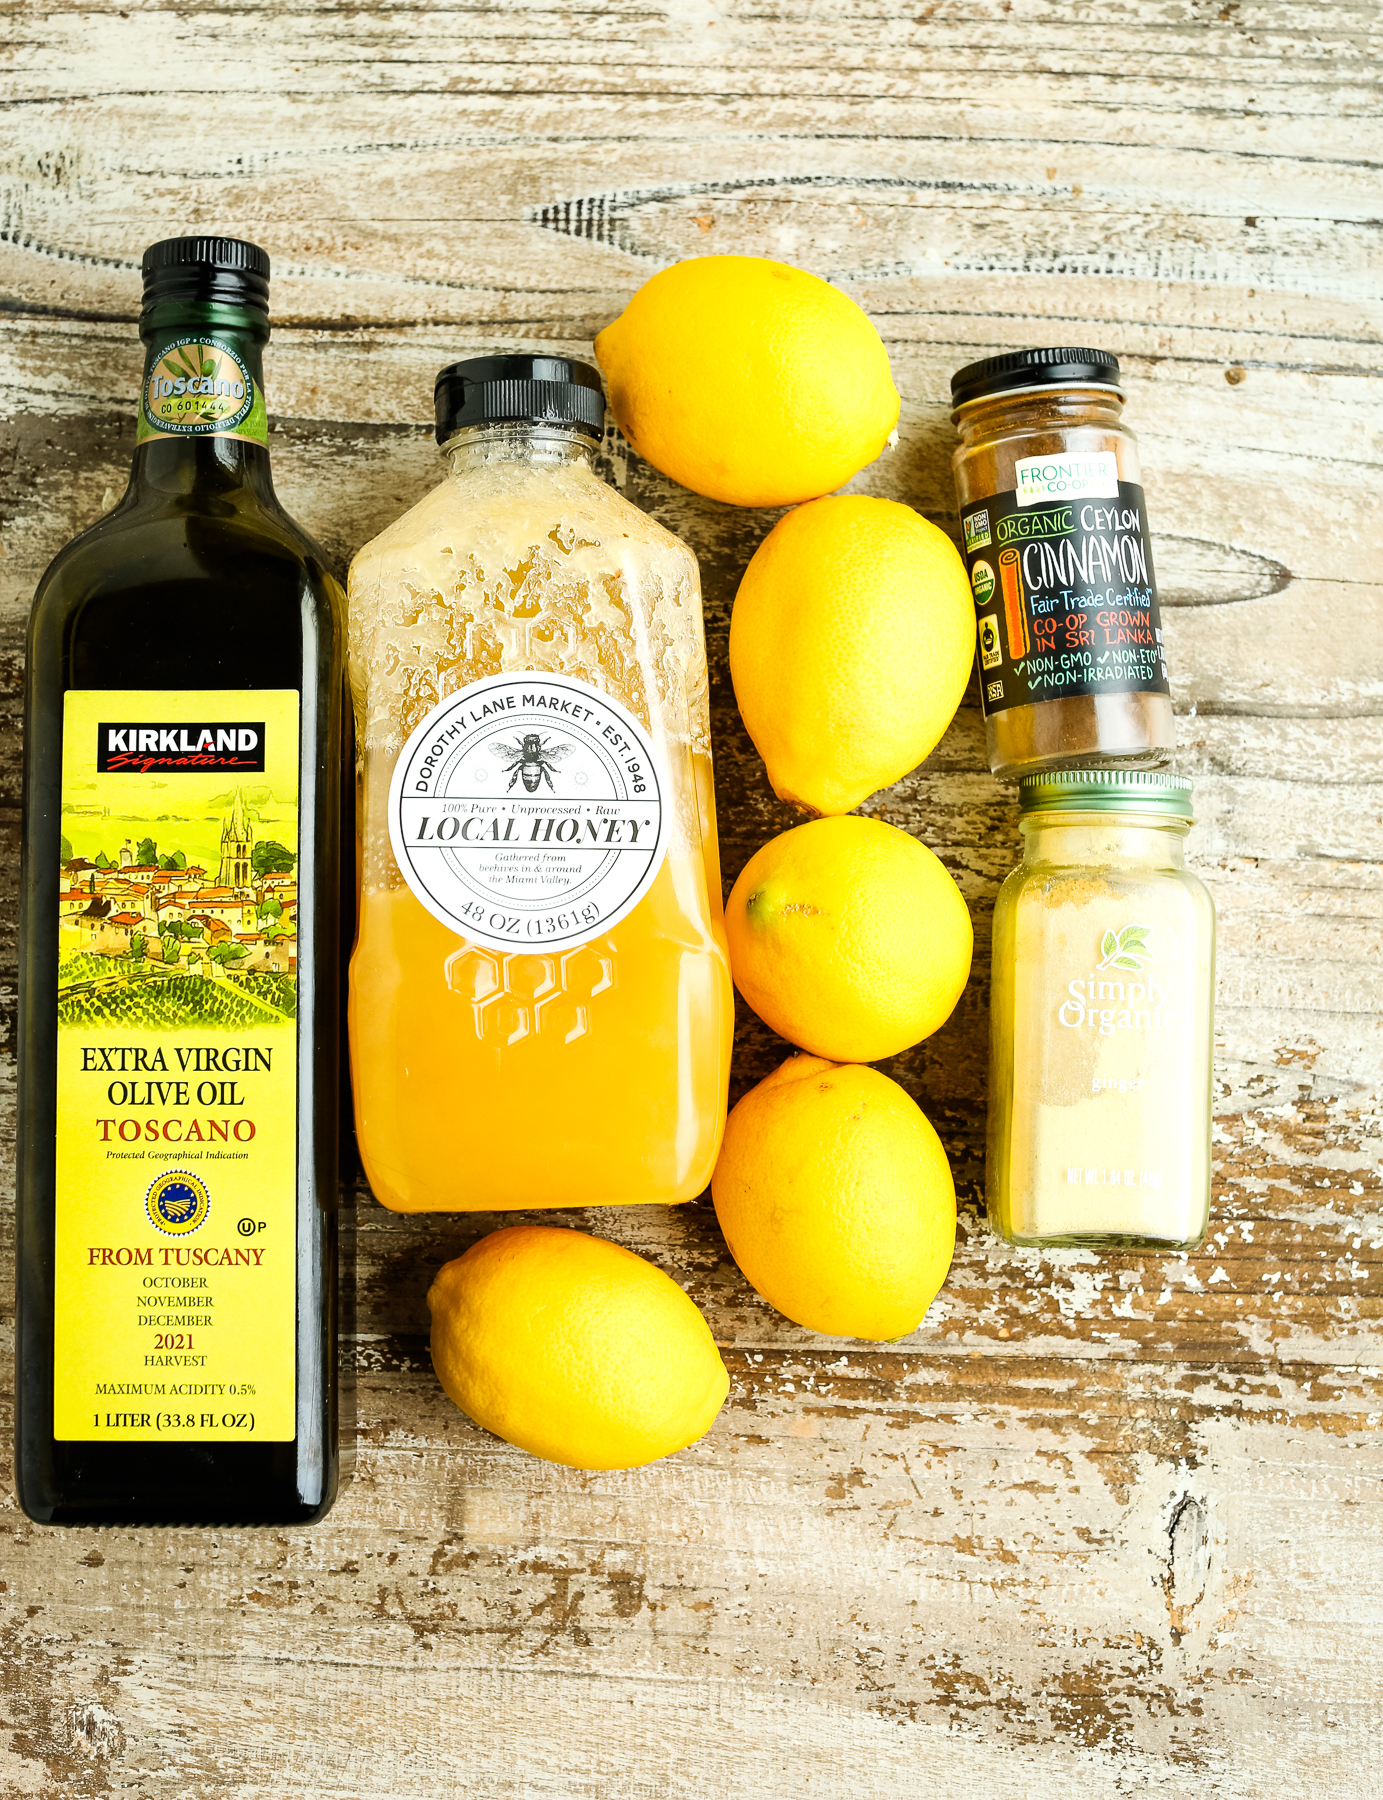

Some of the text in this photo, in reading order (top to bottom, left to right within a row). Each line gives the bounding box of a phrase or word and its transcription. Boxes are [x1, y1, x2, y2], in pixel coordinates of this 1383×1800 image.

[176, 338, 191, 348] IGP
[200, 338, 242, 364] CONSORZIO
[240, 362, 250, 380] PER
[152, 375, 244, 399] Toscano
[161, 400, 224, 414] CO 601444
[1020, 462, 1108, 485] FRONTIER
[1047, 479, 1088, 492] CO-OP
[974, 512, 986, 522] NON
[974, 520, 988, 528] GMO
[996, 504, 1141, 541] ORGANIC CEYLON
[1023, 535, 1148, 590] CINNAMON
[974, 569, 988, 583] USDA
[1030, 595, 1059, 616] Fair
[1060, 589, 1104, 610] Trade
[1033, 610, 1150, 636] CO-OP GROWN
[1036, 638, 1056, 653] IN
[1066, 630, 1096, 648] SRI
[1105, 628, 1154, 646] LANKA
[1026, 651, 1092, 675] NON-GMO
[1043, 666, 1154, 688] NON-IRRADIATED
[108, 729, 258, 751] KIRKLAND
[416, 694, 646, 794] DOROTHY LANE MARKET EST. 1948
[107, 752, 258, 774] Signature
[442, 803, 620, 816] 100% Pure Unprocessed Raw
[416, 817, 650, 844] LOCAL HONEY
[494, 853, 566, 863] Gathered from
[479, 864, 582, 874] beehives in & around
[489, 875, 572, 886] the Miami Valley.
[461, 901, 600, 938] 48 OZ (1361g)
[1068, 972, 1172, 1010] Simply
[80, 1047, 273, 1072] EXTRA VIRGIN
[1092, 1074, 1144, 1092] ginger
[108, 1081, 245, 1106] OLIVE OIL
[96, 1118, 256, 1142] TOSCANO
[106, 1150, 248, 1161] Protected Geographical Indication
[1067, 1168, 1084, 1184] NET
[1102, 1169, 1122, 1185] 1.64
[88, 1248, 266, 1266] FROM TUSCANY
[142, 1276, 208, 1288] OCTOBER
[136, 1296, 214, 1308] NOVEMBER
[138, 1315, 214, 1326] DECEMBER
[154, 1334, 195, 1350] 2021
[144, 1355, 208, 1366] HARVEST
[95, 1384, 256, 1396] MAXIMUM ACIDITY 0.5%
[94, 1412, 256, 1432] 1 LITER (33.8 FL OZ)
